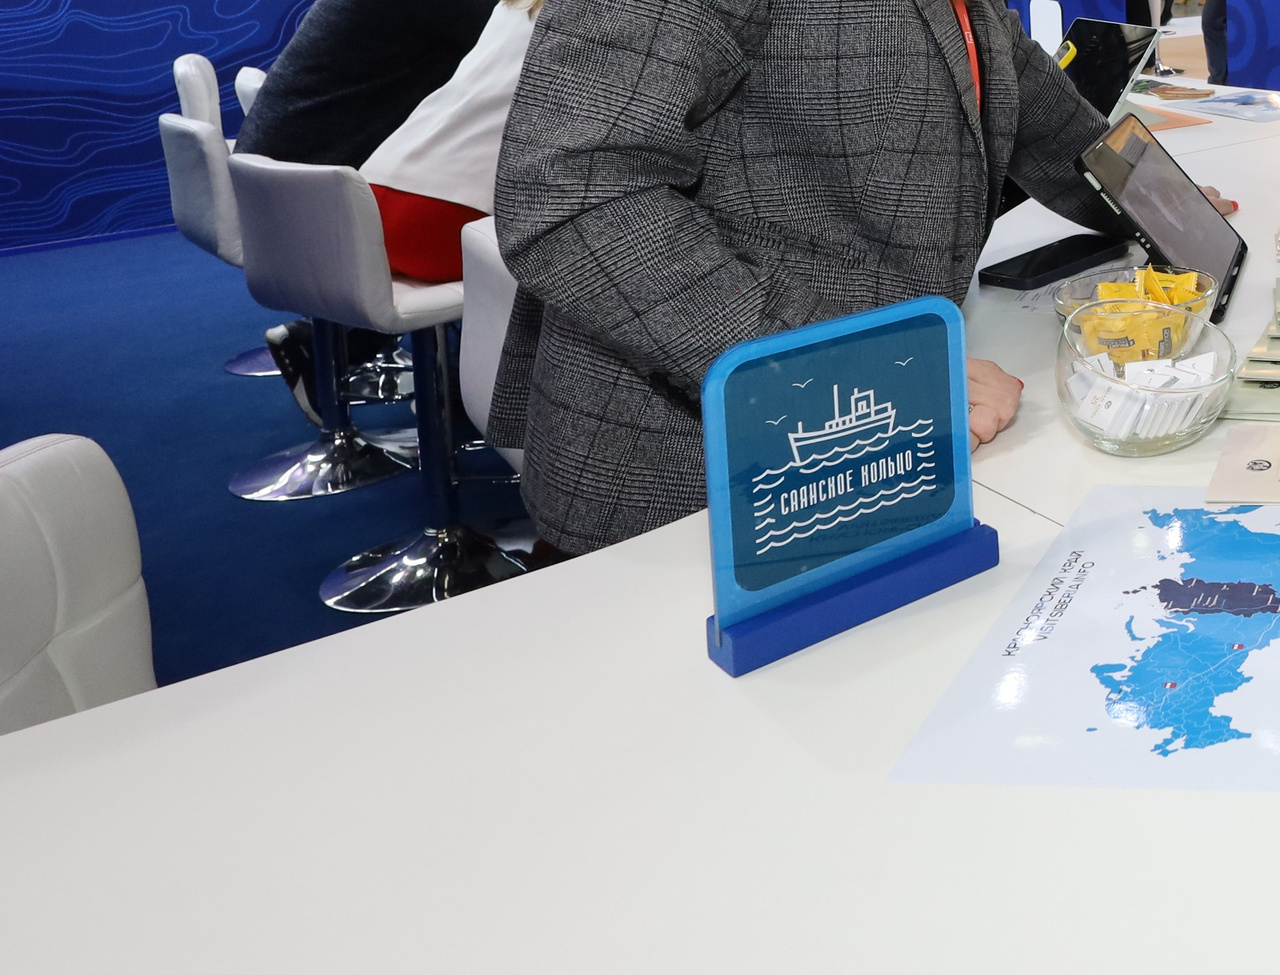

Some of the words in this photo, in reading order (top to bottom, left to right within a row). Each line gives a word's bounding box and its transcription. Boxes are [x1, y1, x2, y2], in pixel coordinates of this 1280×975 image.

[780, 469, 855, 516] САЯНСКОЕ
[861, 449, 914, 488] КОЛЬЦО
[1034, 560, 1095, 642] VISITSIBERIA.INFO
